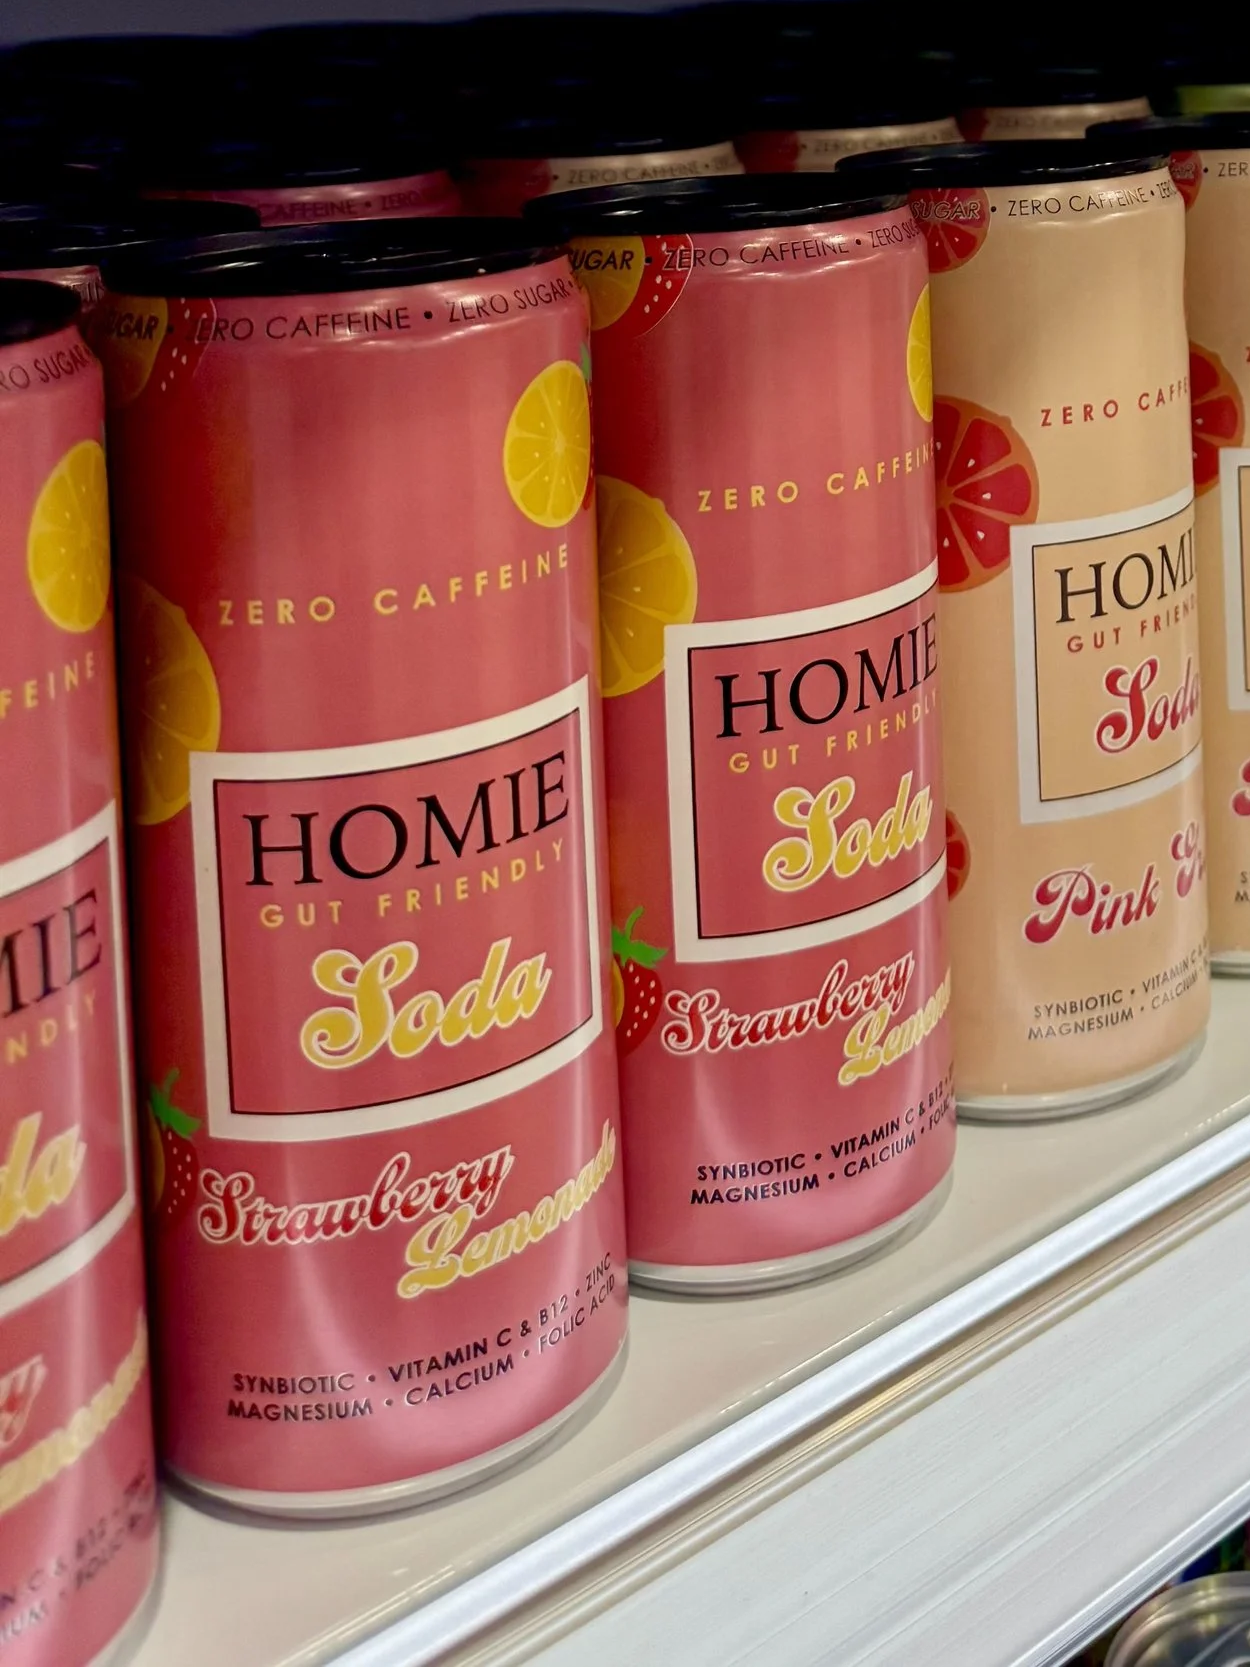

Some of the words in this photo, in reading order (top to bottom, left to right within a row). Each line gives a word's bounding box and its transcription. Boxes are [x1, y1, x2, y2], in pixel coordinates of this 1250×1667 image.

[568, 168, 615, 186] ZERO
[909, 200, 981, 221] SUGAR
[1007, 196, 1062, 218] ZERO
[1068, 187, 1149, 213] CAFFEINE
[663, 246, 730, 271] ZERO
[739, 238, 850, 265] CAFFEINE
[869, 227, 902, 251] ZERO
[265, 307, 412, 341] CAFFEINE
[448, 291, 511, 324] ZERO
[517, 276, 570, 311] SUGAR
[34, 340, 92, 384] SUGAR
[1040, 398, 1120, 428] ZERO
[698, 480, 799, 513] ZERO
[218, 595, 336, 627] ZERO
[372, 542, 570, 615] CAFFEINE
[714, 611, 939, 739] HOMIE
[1066, 626, 1122, 654] GUT
[728, 743, 800, 774] GUT
[242, 749, 571, 889] HOMIE
[762, 770, 934, 893] Soda
[258, 900, 344, 929] GUT
[377, 838, 565, 918] FRIENDLY
[1023, 861, 1161, 946] Pink
[299, 936, 554, 1071] Soda
[661, 950, 916, 1057] Strawberry
[1033, 988, 1125, 1019] SYNBIOTIC
[1142, 955, 1190, 994] VITAMIN
[1027, 1006, 1135, 1040] MAGNESIUM
[690, 1173, 820, 1205] MAGNESIUM
[843, 1131, 917, 1178] CALCIUM
[696, 1152, 806, 1182] SYNBIOTIC
[830, 1116, 900, 1159] VITAMIN
[198, 1144, 516, 1246] Strawberry
[227, 1397, 374, 1423] MAGNESIUM
[404, 1356, 515, 1407] CALCIUM
[537, 1307, 586, 1356] FOLIC
[589, 1272, 617, 1317] ACID
[232, 1371, 356, 1395] SYNBIOTIC
[387, 1336, 489, 1384] VITAMIN
[496, 1326, 512, 1349] C
[518, 1318, 532, 1338] &
[538, 1293, 570, 1329] B12
[585, 1251, 613, 1295] ZINC
